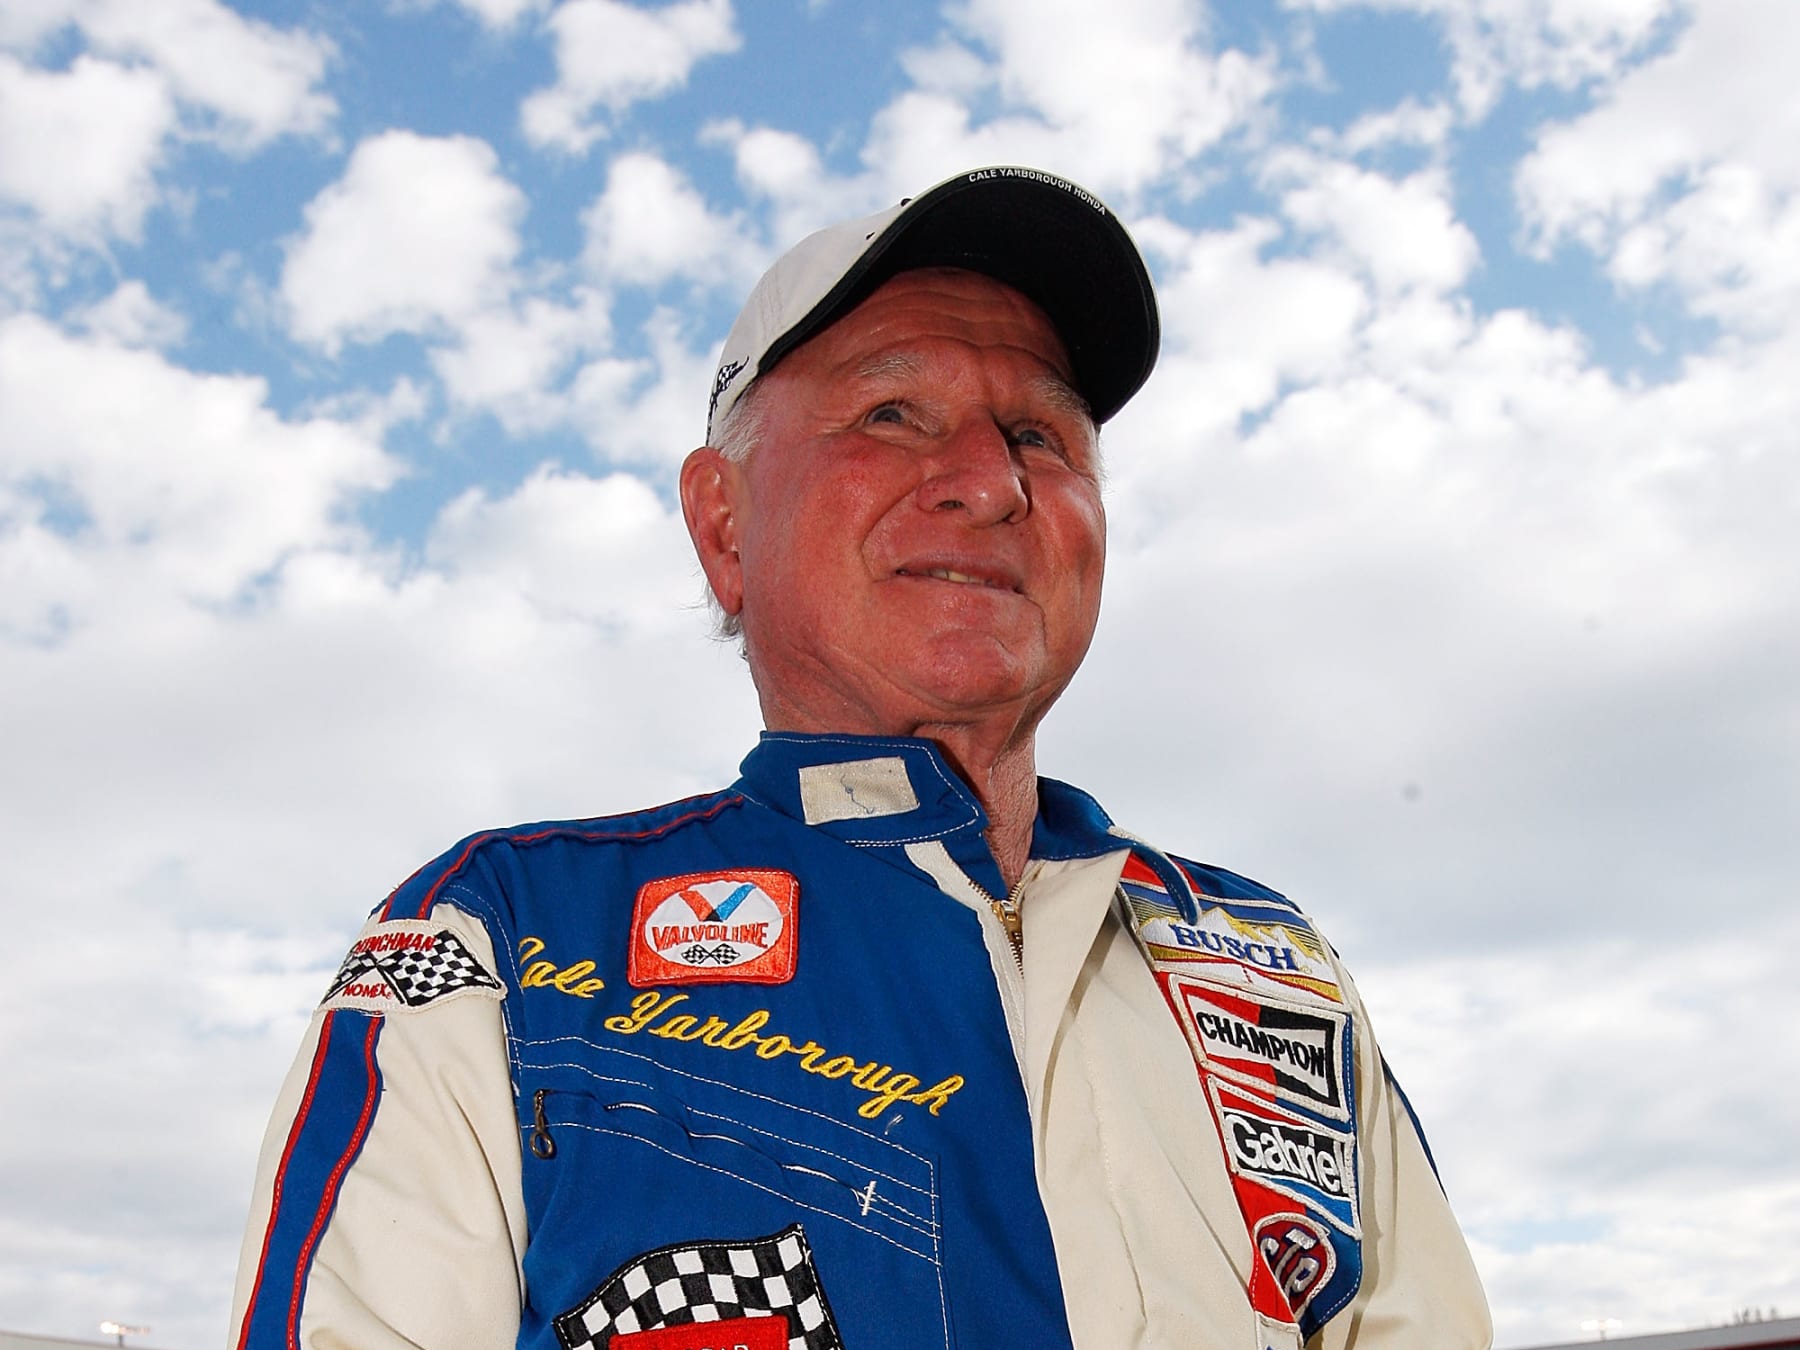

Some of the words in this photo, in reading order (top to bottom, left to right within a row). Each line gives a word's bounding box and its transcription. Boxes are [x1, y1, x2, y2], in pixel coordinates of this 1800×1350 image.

[969, 169, 997, 182] CALE
[999, 168, 1072, 192] YARBOROUGH
[1073, 187, 1106, 216] HONDA
[652, 920, 769, 951] VALVOLINE
[1168, 924, 1299, 971] BUSCH
[342, 983, 389, 999] NOMEX
[604, 991, 965, 1120] Yarborough
[1196, 1012, 1326, 1078] CHAMPION
[1224, 1113, 1350, 1194] Gabriel
